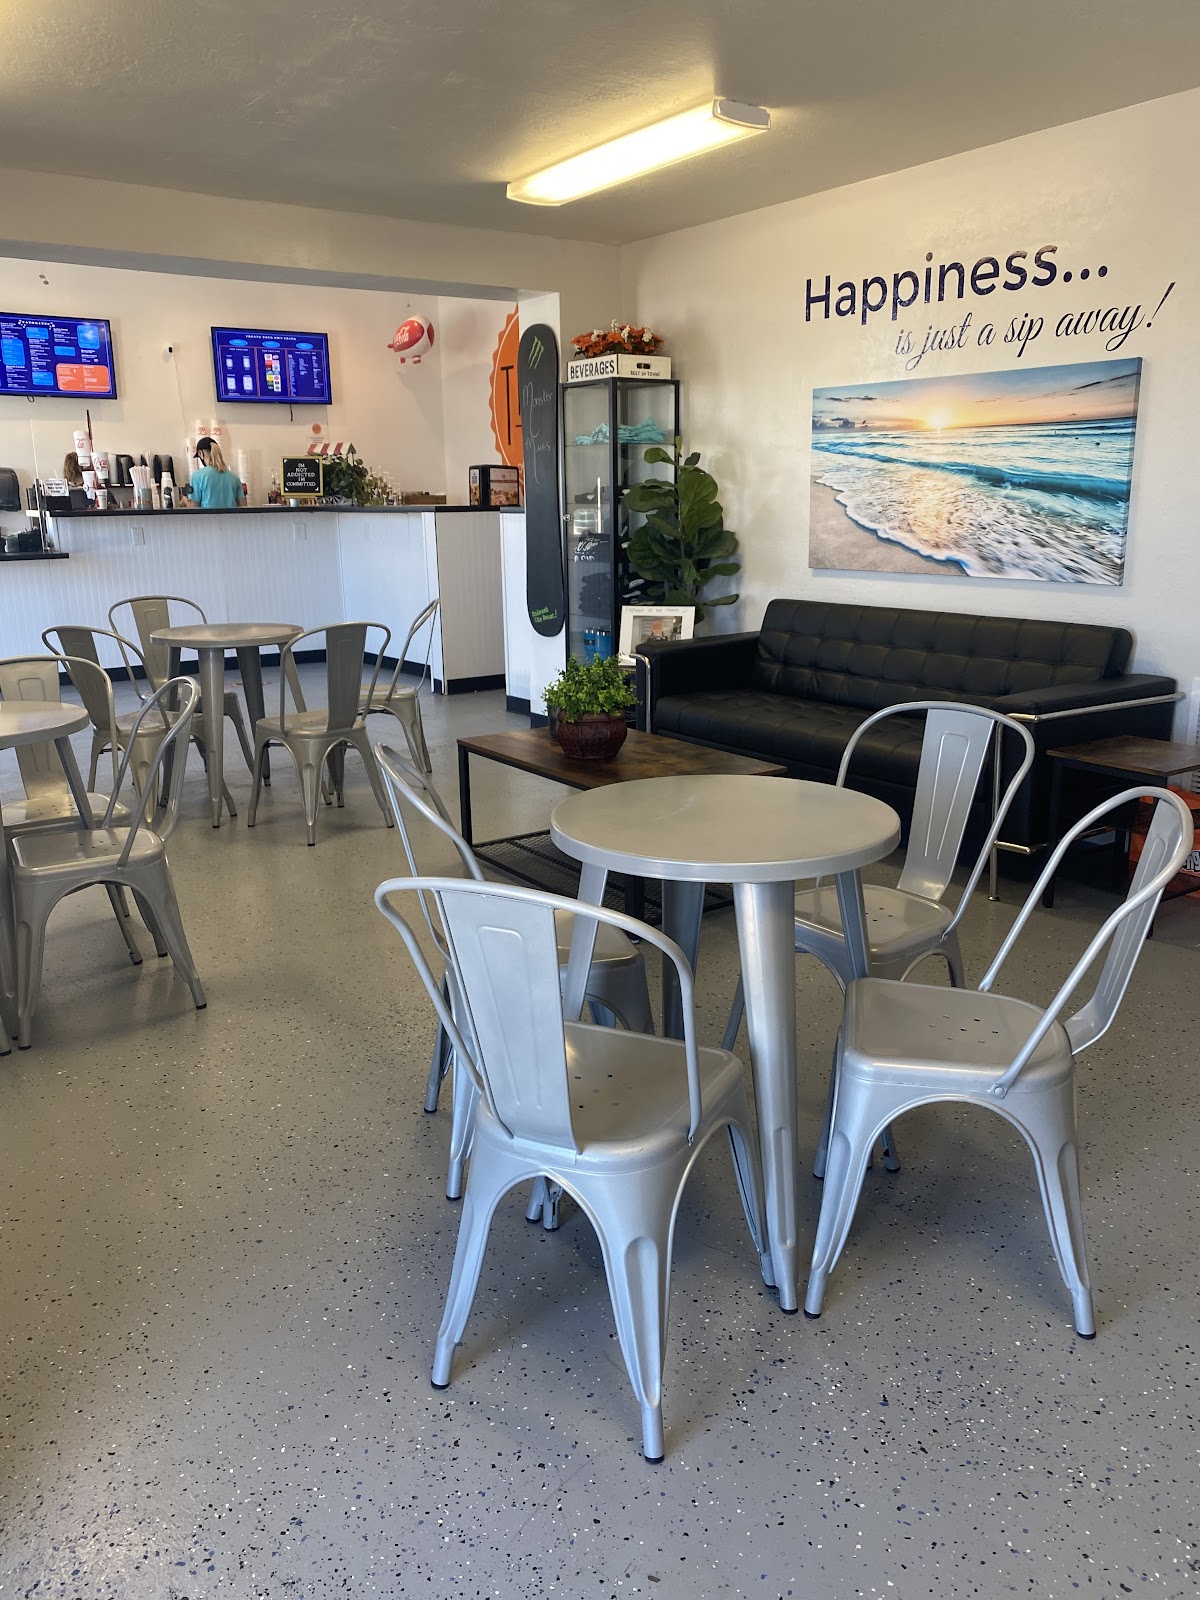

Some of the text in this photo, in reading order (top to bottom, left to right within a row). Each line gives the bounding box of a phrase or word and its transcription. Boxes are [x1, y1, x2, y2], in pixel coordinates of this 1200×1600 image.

[805, 245, 1108, 326] Happiness...
[895, 281, 1176, 371] is just a sip away!
[570, 360, 615, 380] BEVERAGES
